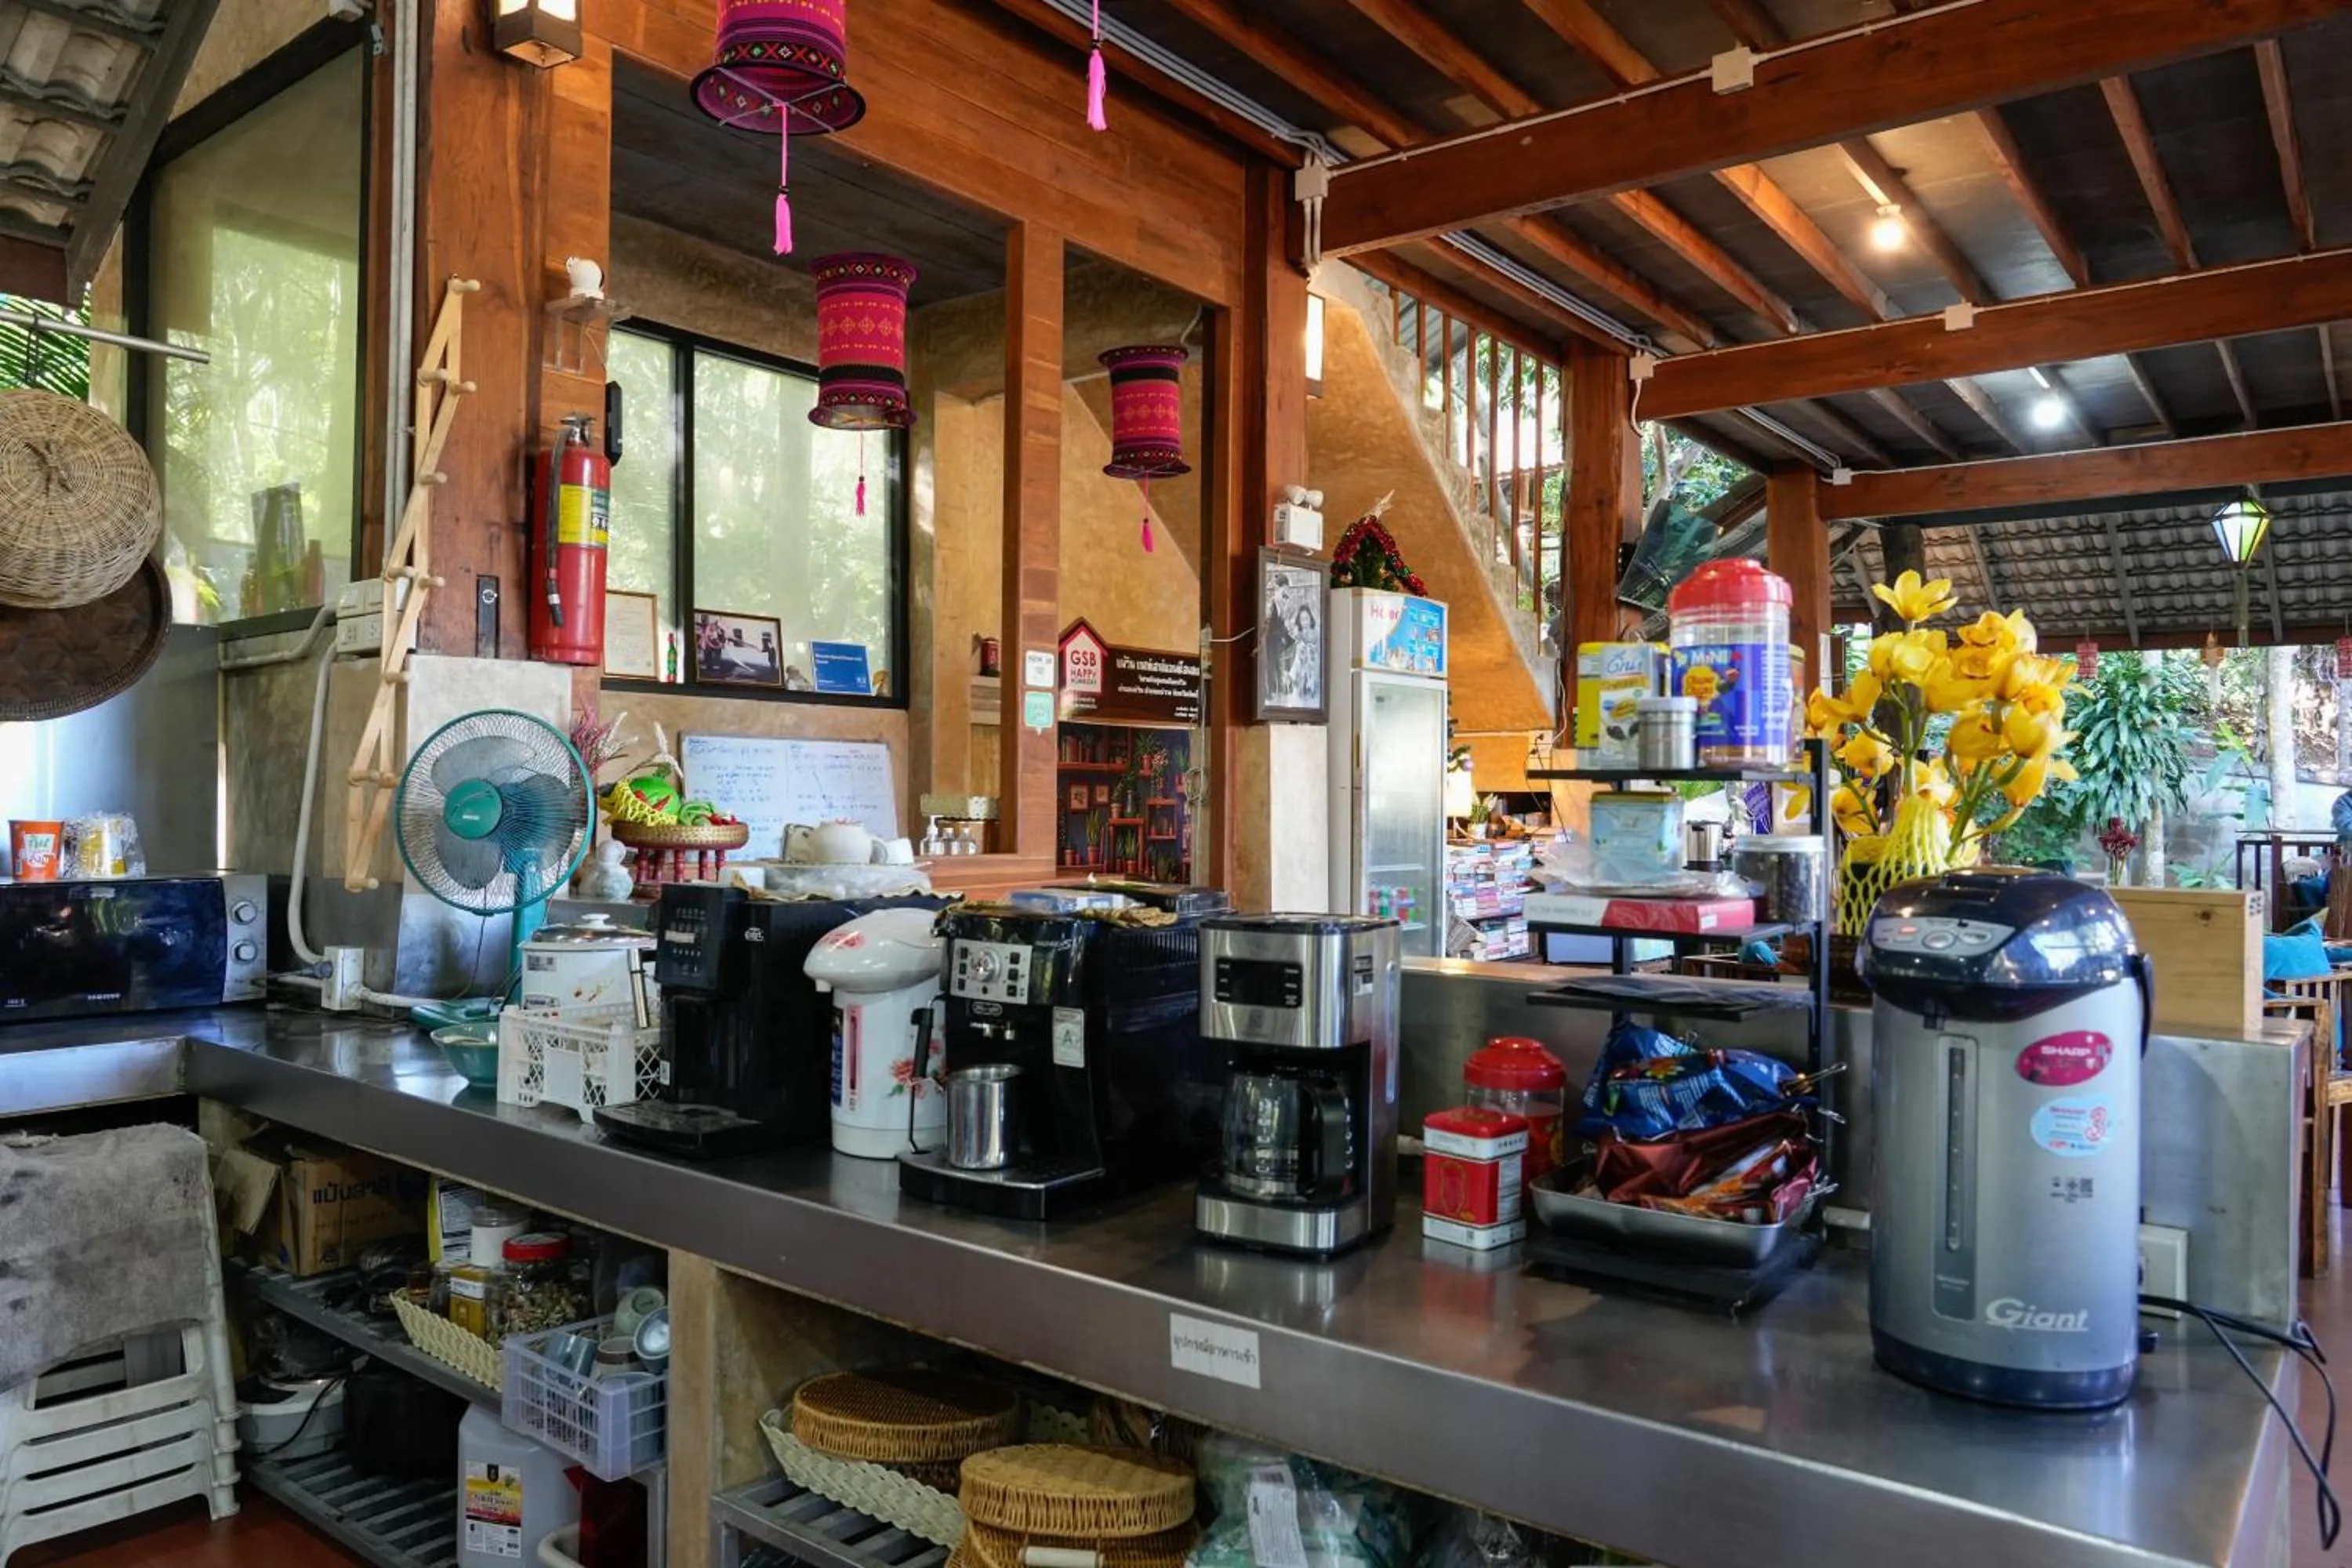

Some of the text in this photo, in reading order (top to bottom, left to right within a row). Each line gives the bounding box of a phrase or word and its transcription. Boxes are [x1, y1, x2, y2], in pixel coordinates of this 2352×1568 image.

[1071, 650, 1096, 666] GSB
[2041, 1045, 2092, 1057] SHARP
[1985, 1298, 2089, 1331] Giant
